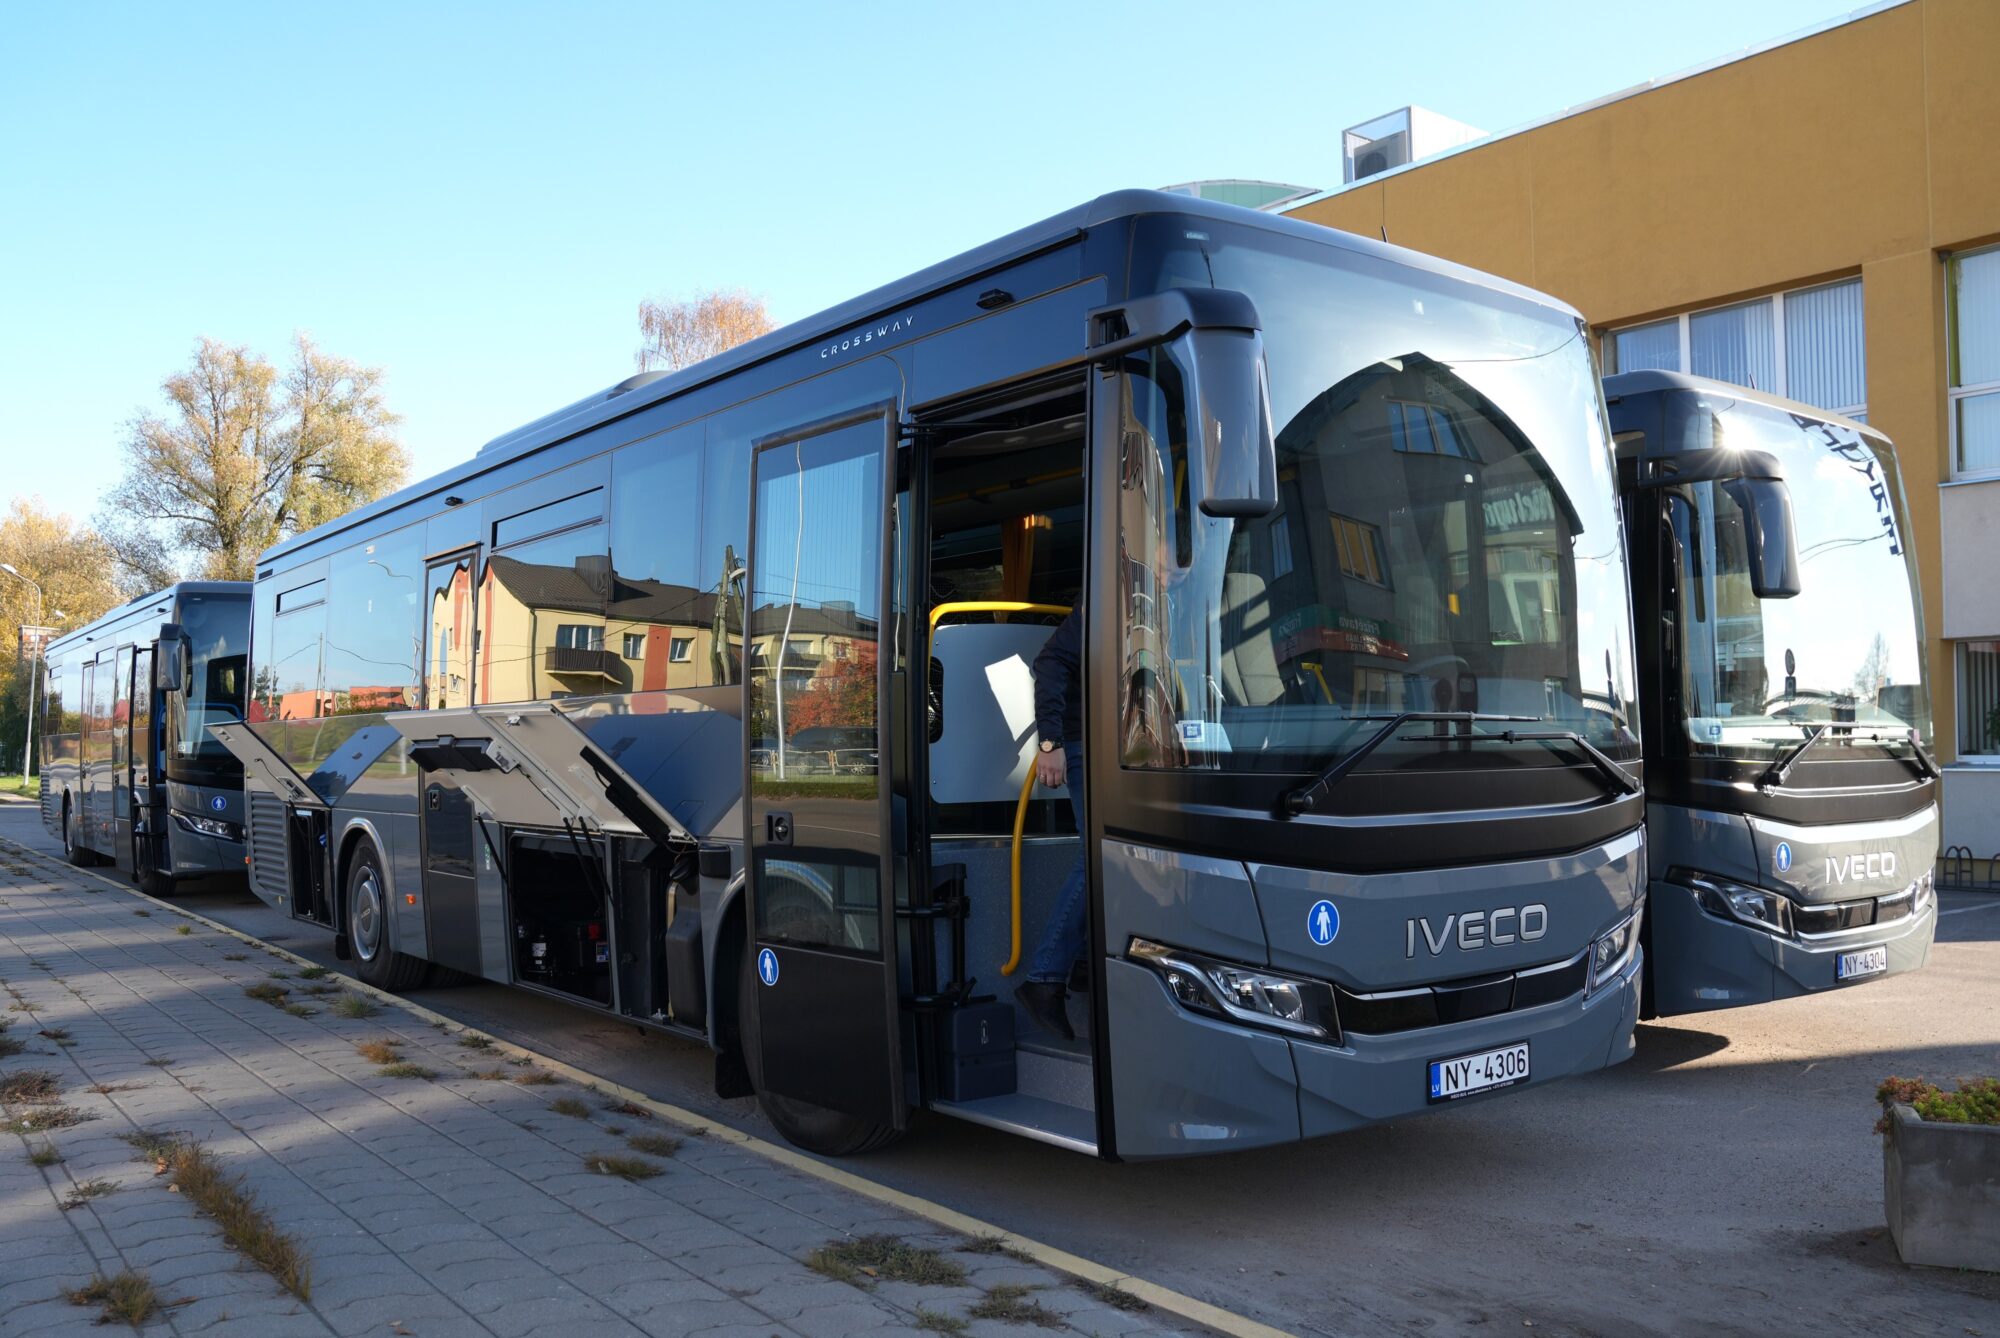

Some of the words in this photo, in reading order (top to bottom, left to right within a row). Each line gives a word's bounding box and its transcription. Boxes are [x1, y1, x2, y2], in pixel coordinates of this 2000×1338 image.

[821, 315, 913, 358] CROSSWAY
[1825, 851, 1896, 885] IVECO
[1405, 903, 1548, 959] IVECO
[1431, 1083, 1440, 1093] LV
[1445, 1049, 1526, 1092] NY-4306
